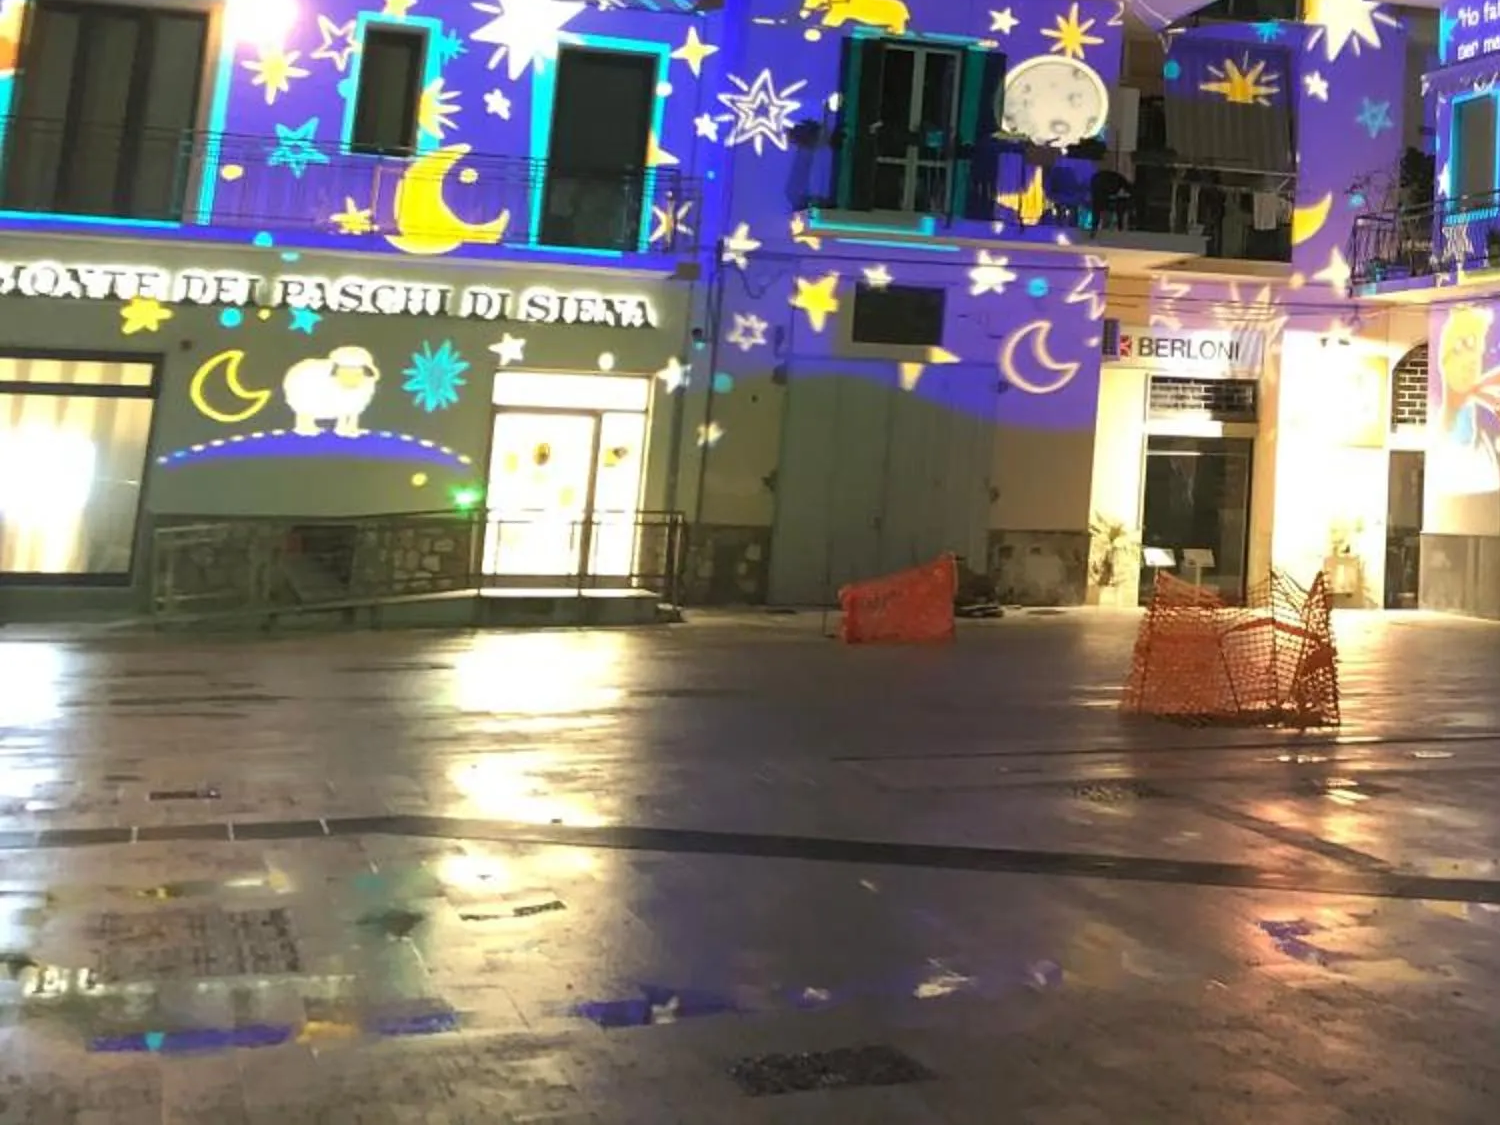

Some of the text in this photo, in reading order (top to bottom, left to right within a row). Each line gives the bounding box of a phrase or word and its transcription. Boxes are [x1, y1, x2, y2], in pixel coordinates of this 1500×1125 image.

[182, 274, 260, 305] DEI
[278, 279, 452, 316] PASCHI
[467, 290, 512, 321] DI
[525, 293, 658, 329] SIENA
[1138, 336, 1241, 362] BERLONI
